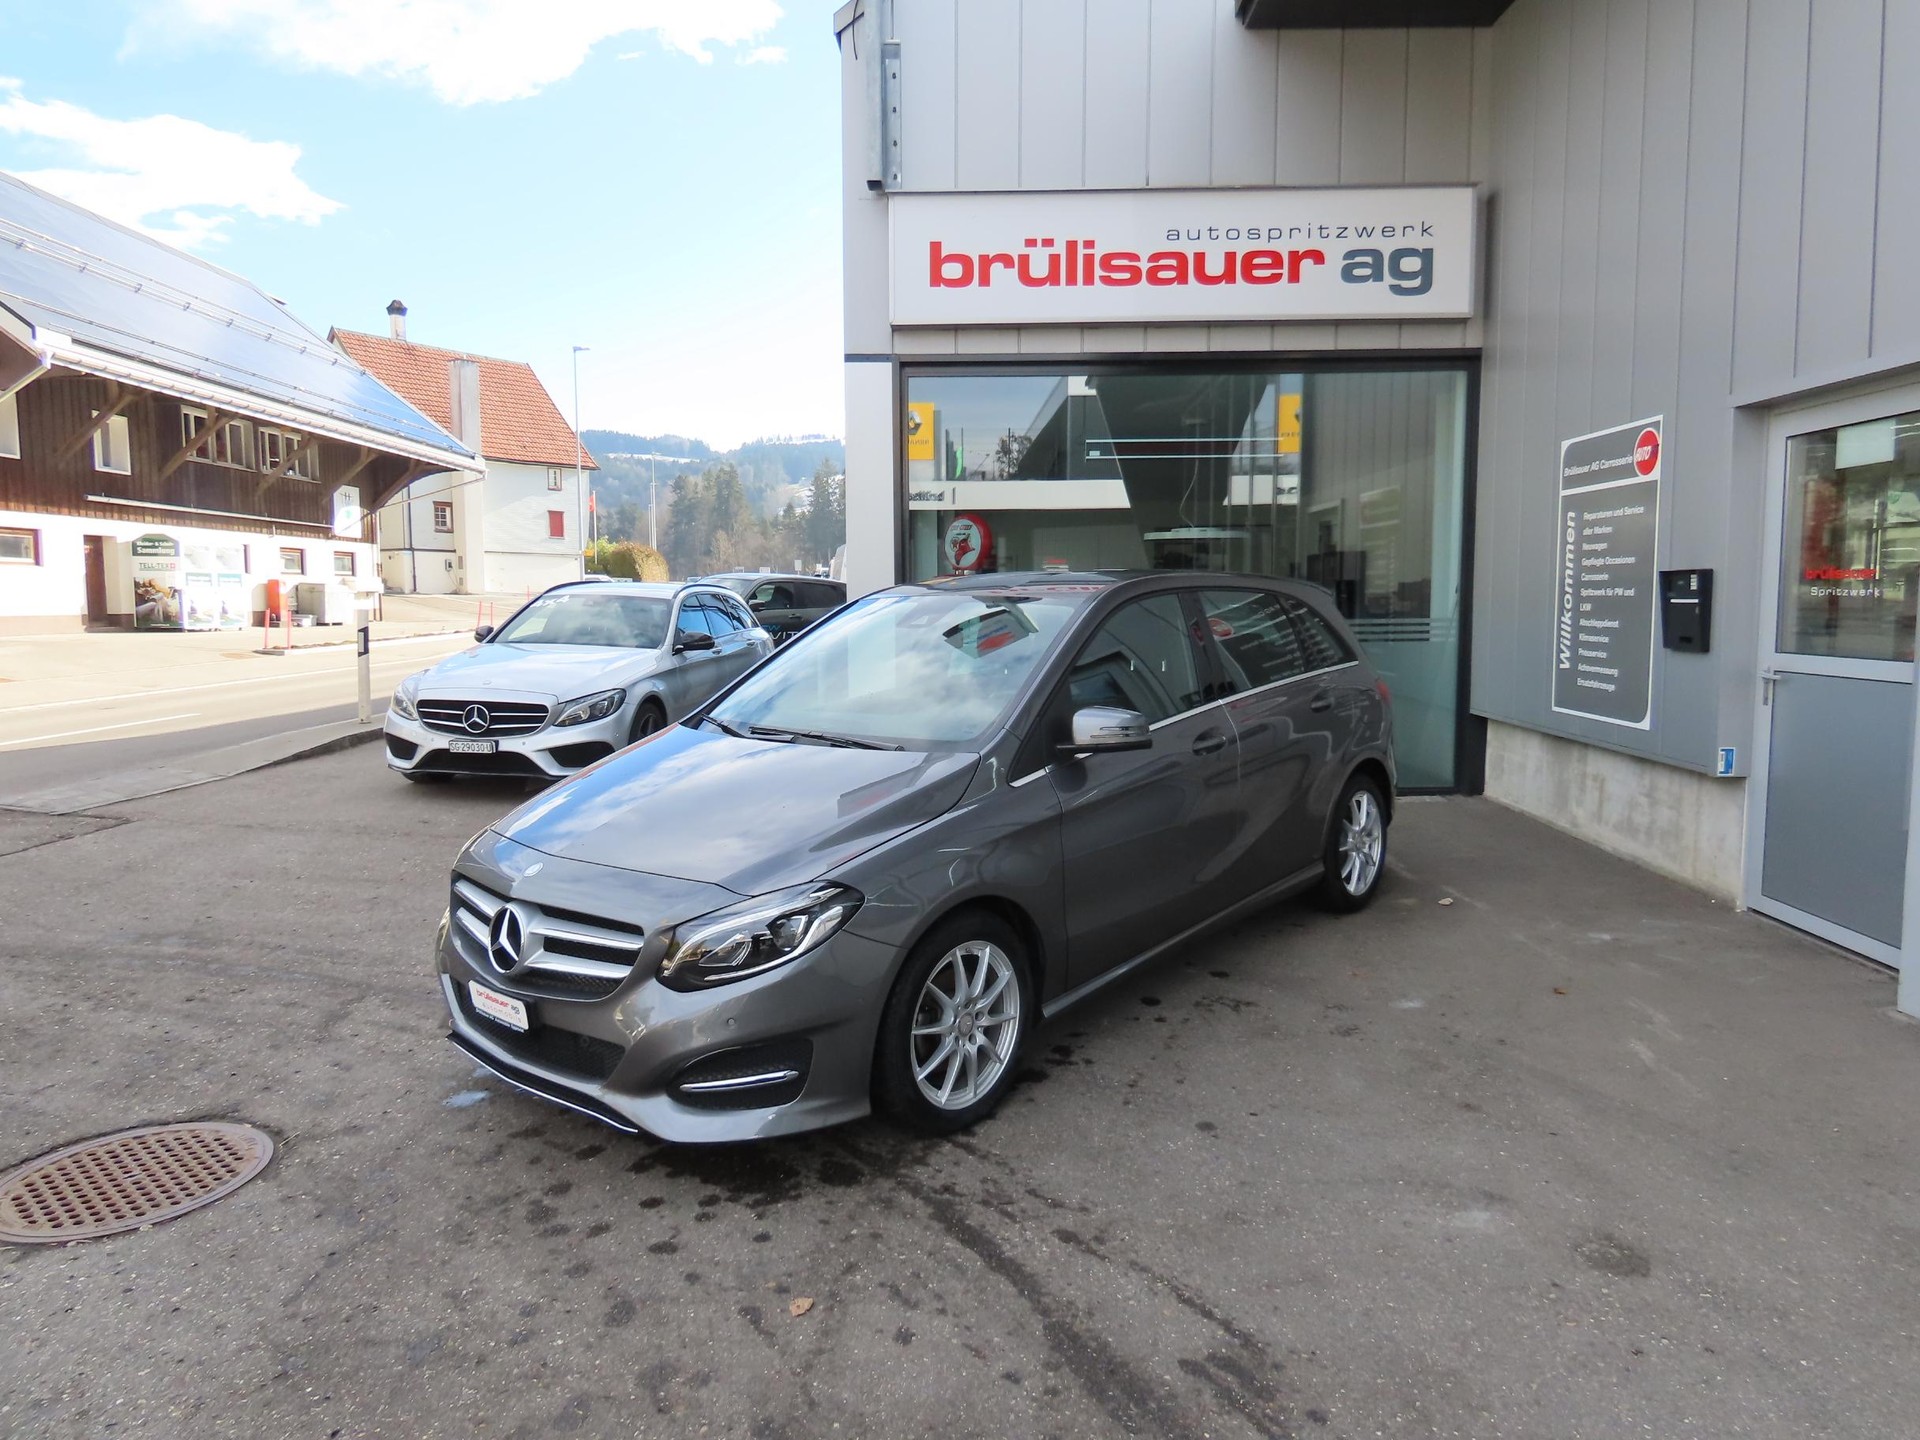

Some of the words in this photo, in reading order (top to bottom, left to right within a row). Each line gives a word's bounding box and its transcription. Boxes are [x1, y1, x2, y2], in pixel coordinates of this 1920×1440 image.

[1165, 221, 1434, 243] autospritzwerk
[929, 238, 1325, 288] brülisauer
[1340, 247, 1434, 296] ag
[1590, 461, 1600, 471] AG
[1624, 506, 1644, 515] Service
[136, 547, 175, 555] Sammlung
[1559, 511, 1576, 669] Willkommen
[1810, 587, 1881, 598] Spritzwerk
[1580, 603, 1592, 611] LKW
